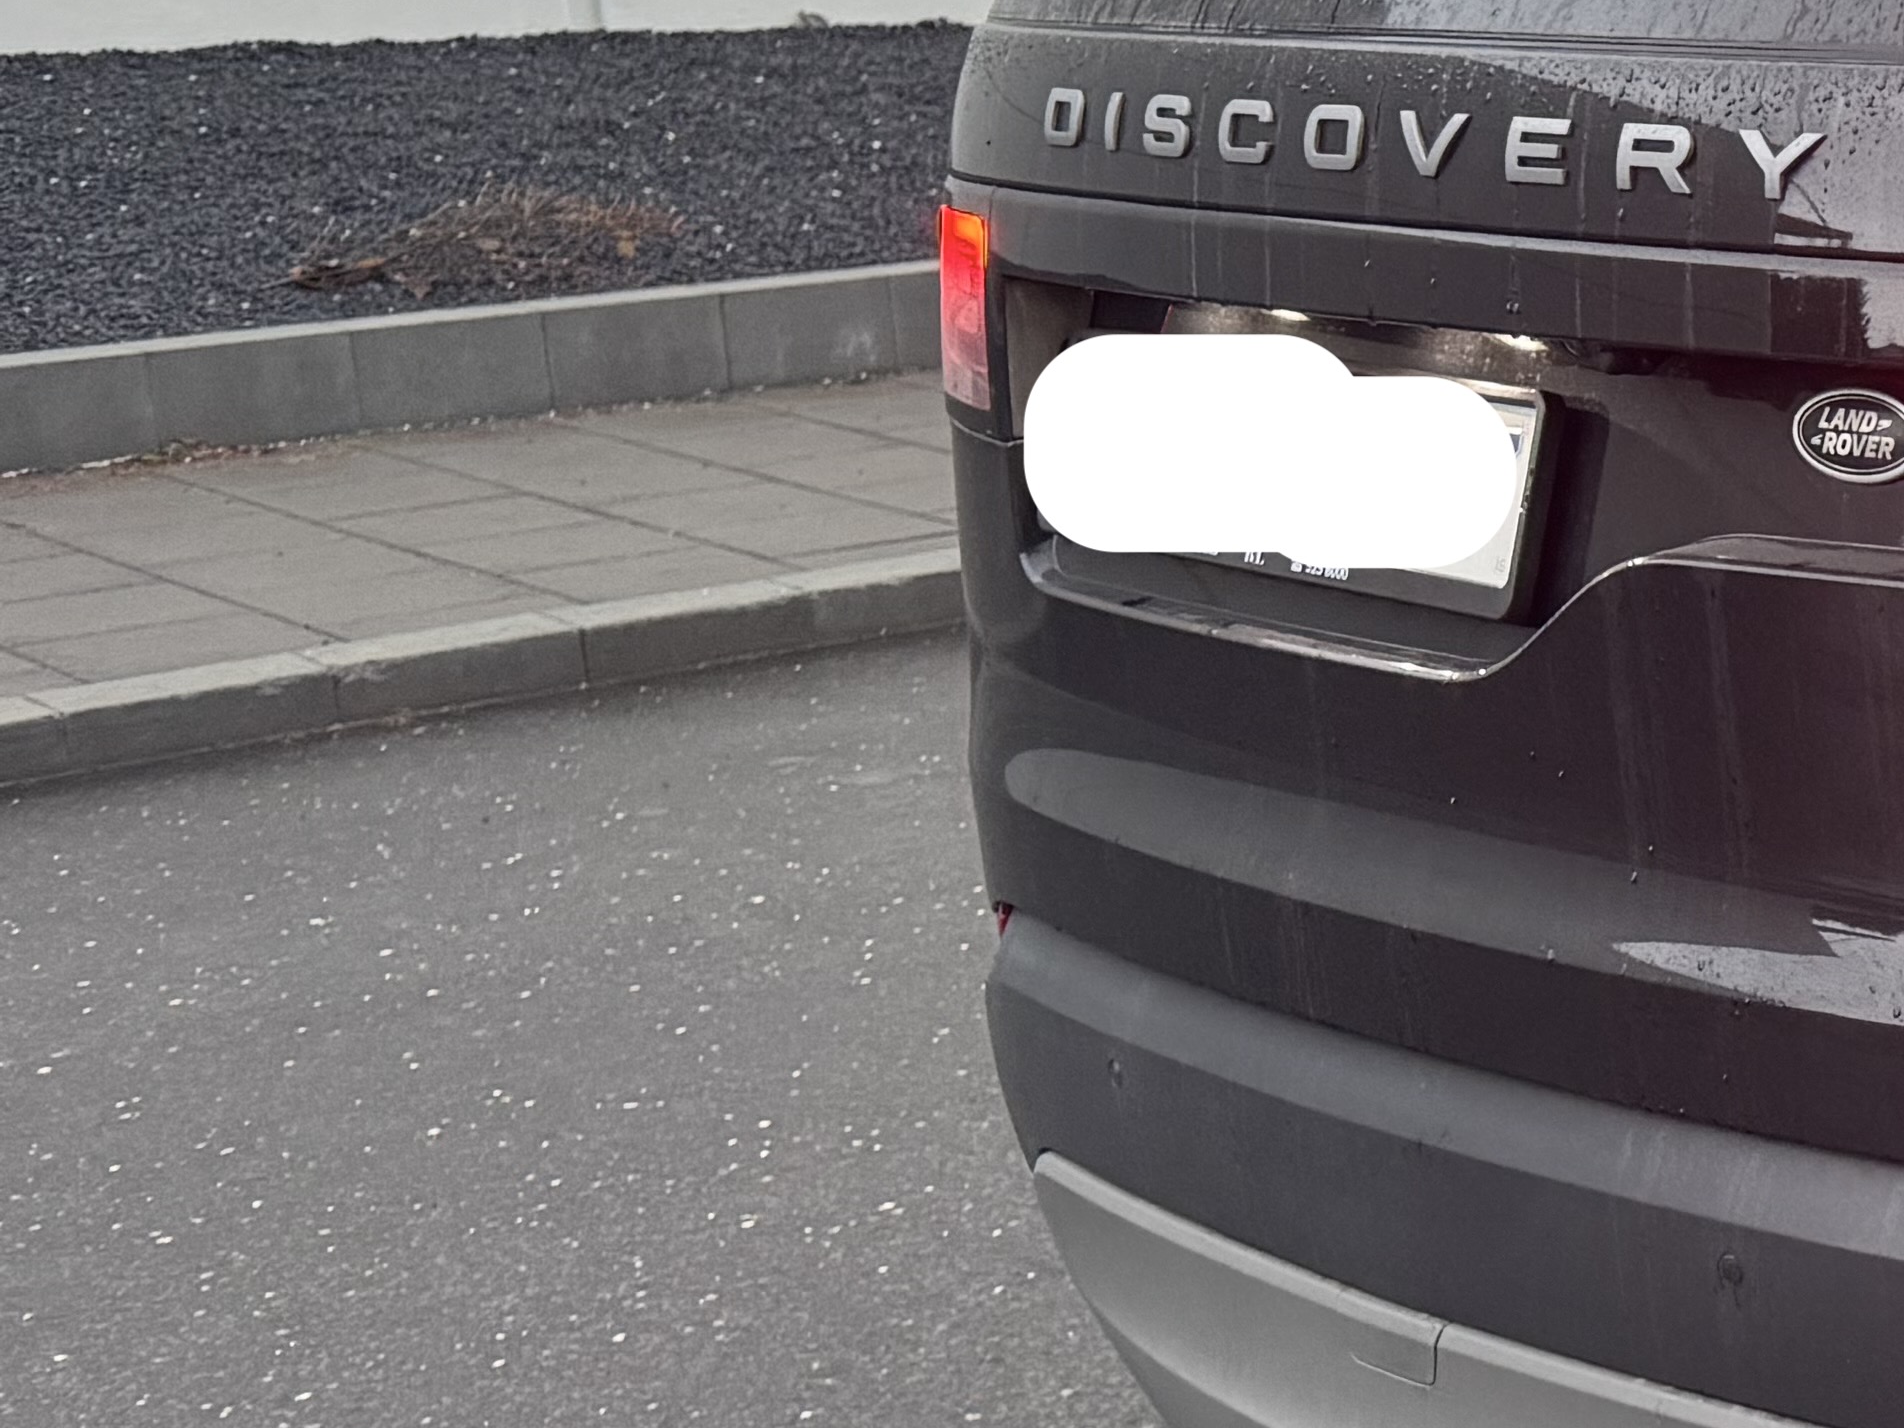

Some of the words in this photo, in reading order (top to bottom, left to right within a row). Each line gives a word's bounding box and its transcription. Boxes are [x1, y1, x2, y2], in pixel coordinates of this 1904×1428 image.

[1043, 86, 1826, 200] DISCOVERY
[1818, 406, 1878, 433] LAND
[1822, 431, 1895, 460] ROVER
